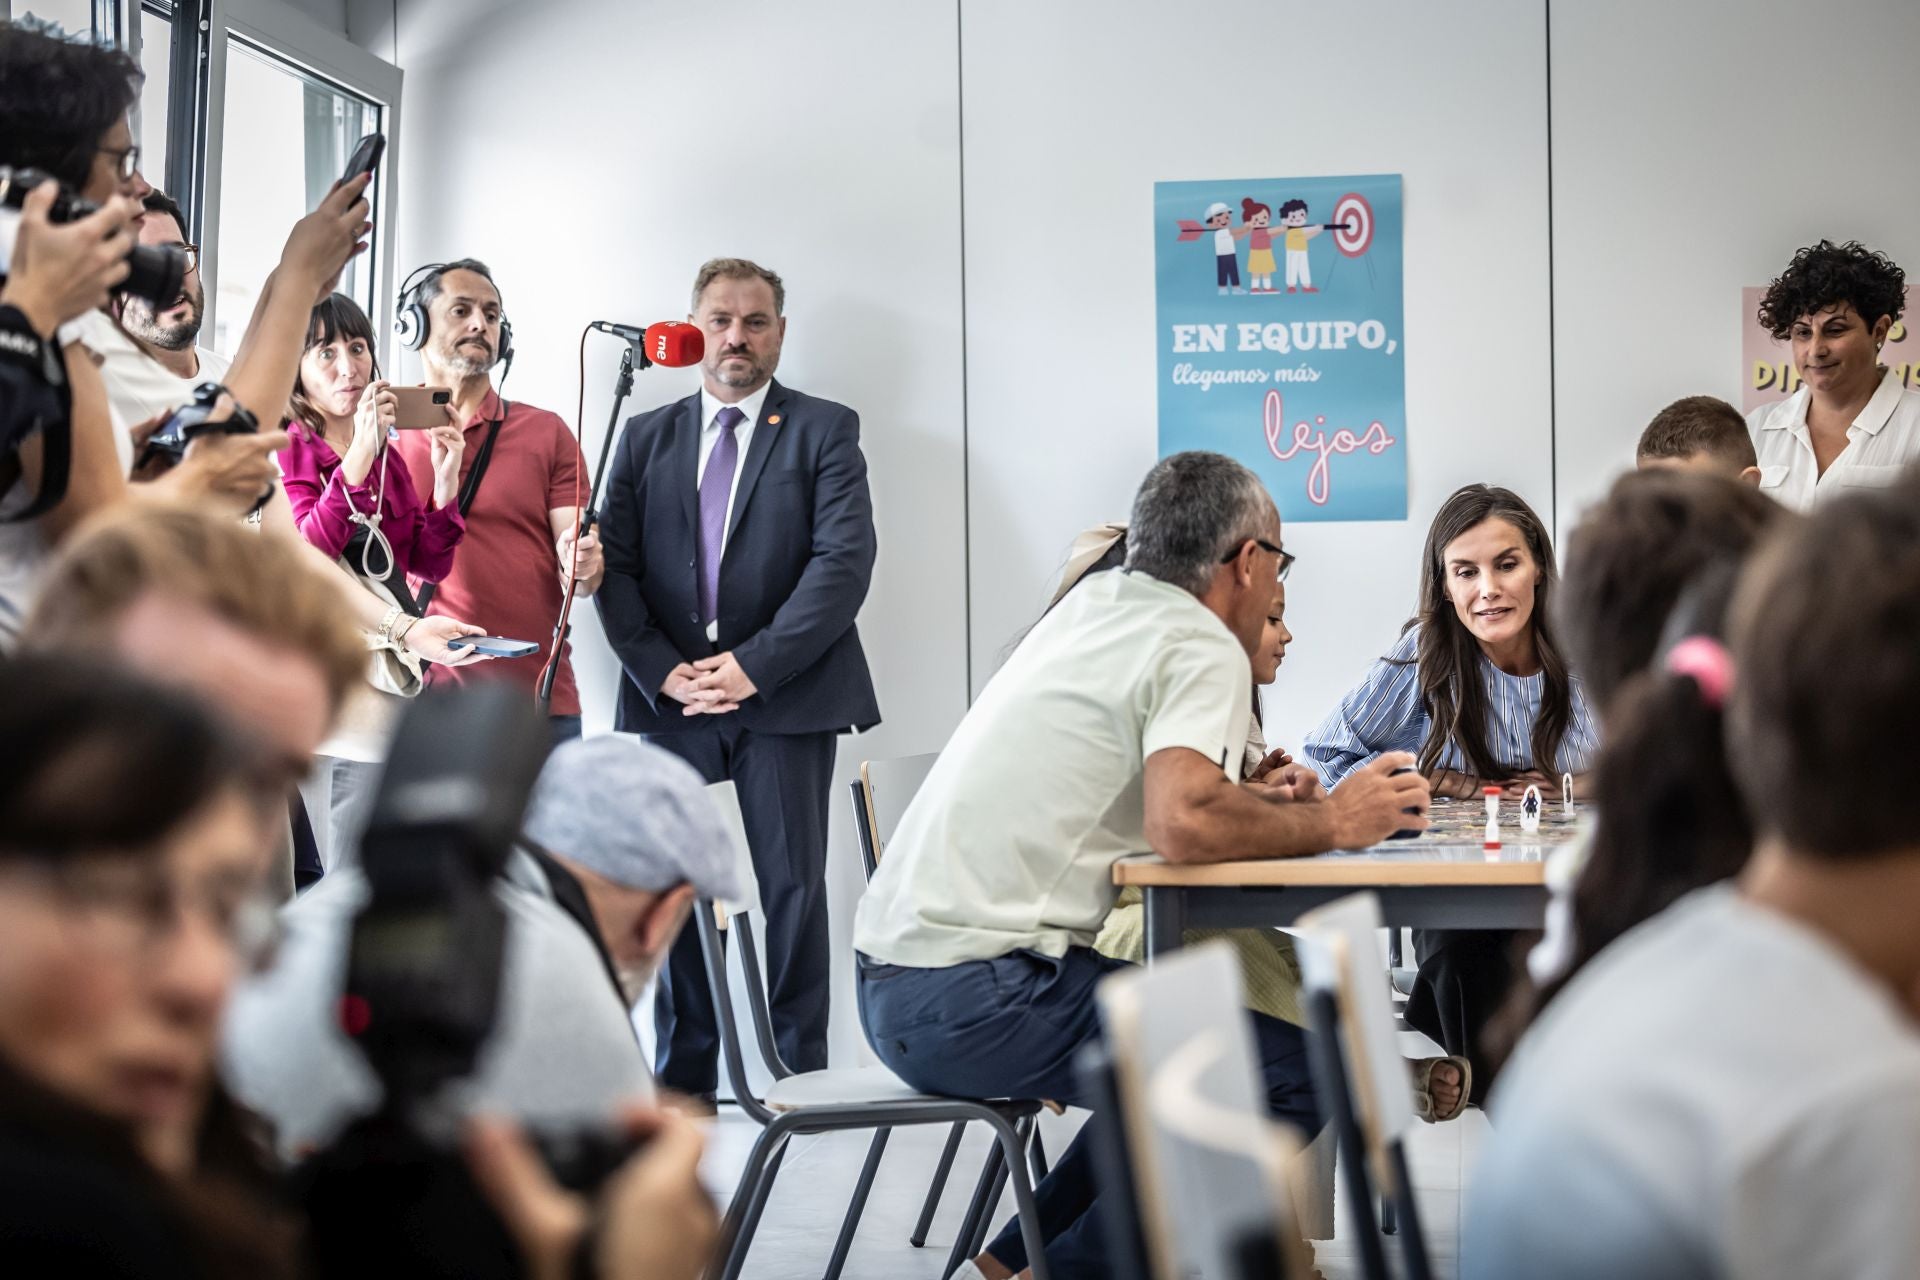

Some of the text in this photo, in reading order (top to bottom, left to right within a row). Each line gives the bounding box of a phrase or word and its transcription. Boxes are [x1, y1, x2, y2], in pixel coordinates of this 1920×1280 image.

[1173, 320, 1397, 355] EN EQUIPO,
[1172, 363, 1322, 391] llegamos más
[1263, 389, 1395, 505] lejos
